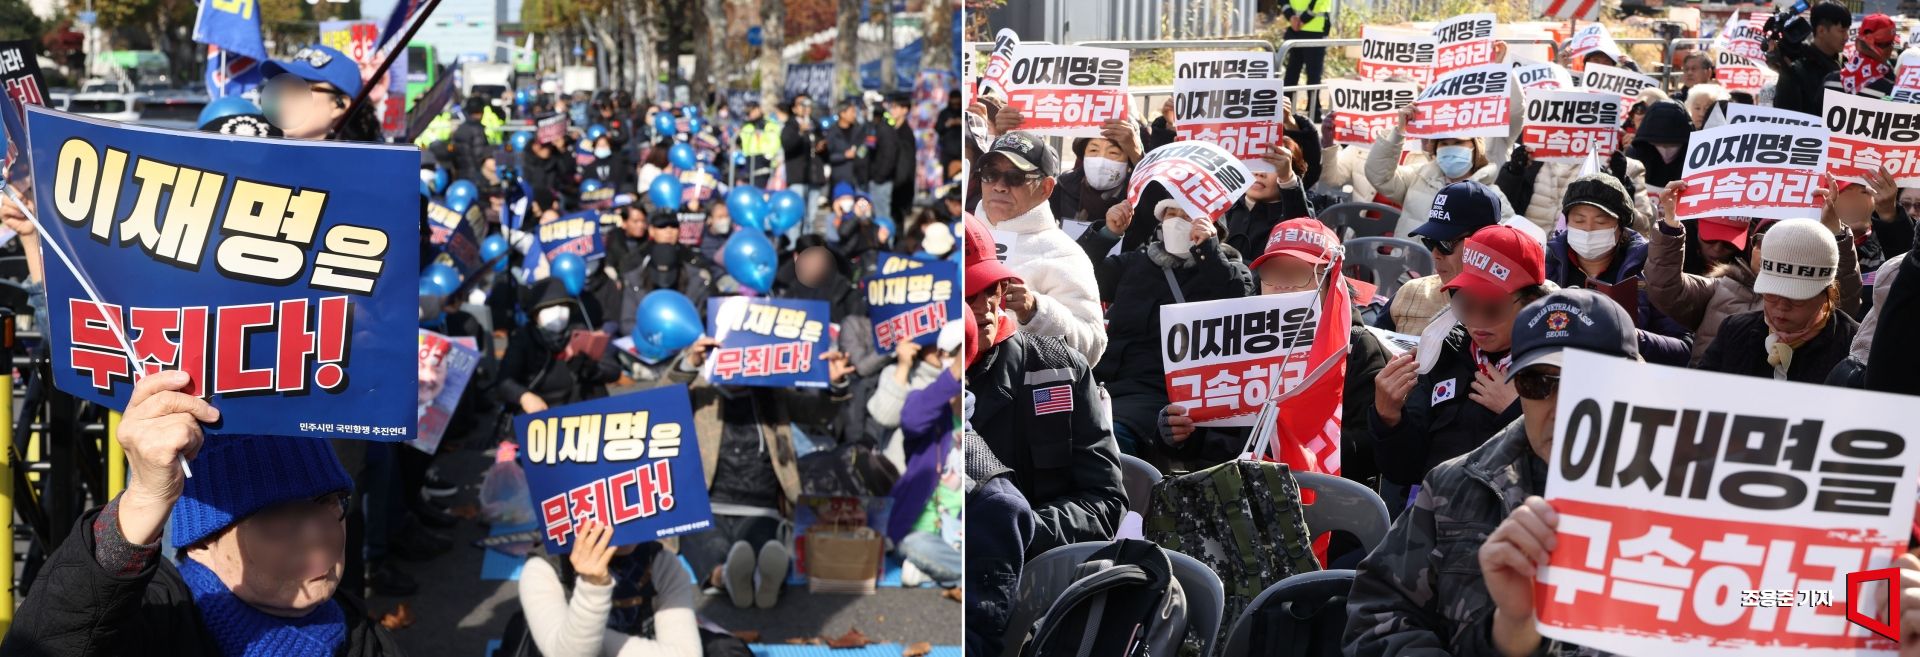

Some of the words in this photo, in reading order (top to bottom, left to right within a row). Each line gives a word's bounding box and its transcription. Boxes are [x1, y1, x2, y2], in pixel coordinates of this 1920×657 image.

[1362, 39, 1435, 63] 이재명을
[1439, 42, 1493, 68] 속하라
[1012, 57, 1124, 86] 이재명을
[1718, 69, 1766, 87] 구속하
[1012, 93, 1125, 123] 구속하라
[1175, 88, 1278, 121] 이재명을
[1335, 88, 1414, 112] 이재명을
[1408, 100, 1507, 129] 구속하라
[1528, 99, 1618, 125] 이재명을
[1526, 128, 1619, 154] 구속하라
[1688, 133, 1823, 170] 이재명을
[1679, 171, 1821, 207] 구속하라
[53, 137, 389, 293] 이재명은
[868, 274, 952, 306] 이재명은
[1547, 303, 1580, 315] VETERANS
[875, 300, 948, 350] 무죄다!
[1167, 307, 1317, 363] 이재명을
[1545, 330, 1569, 338] SEOUL
[68, 296, 351, 399] 무죄다!
[714, 341, 813, 380] 무죄다!
[299, 422, 335, 432] 민주시민
[336, 424, 370, 435] 국민항쟁
[372, 426, 407, 436] 추진연대
[527, 411, 682, 464] 이재명은
[1560, 398, 1907, 517] 이재명을
[541, 458, 675, 546] 무죄다!
